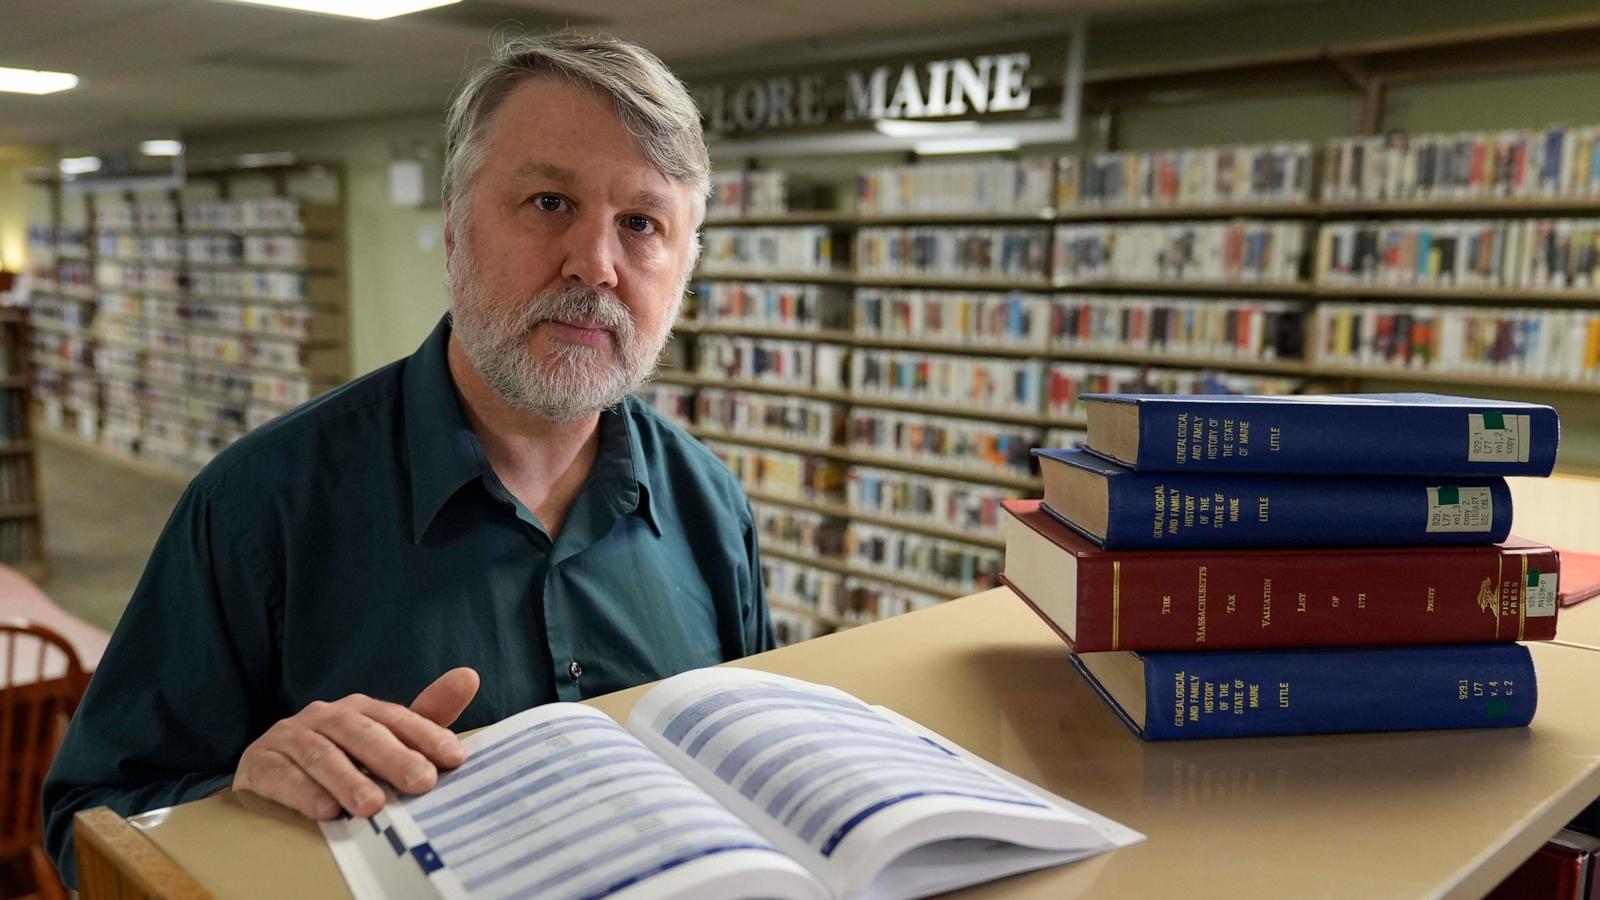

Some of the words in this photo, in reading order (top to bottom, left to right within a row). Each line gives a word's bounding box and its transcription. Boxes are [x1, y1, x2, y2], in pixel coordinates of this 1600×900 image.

[844, 52, 1031, 120] MAINE
[1193, 416, 1203, 442] FAMILY
[1209, 418, 1218, 427] OF
[1224, 419, 1234, 442] STATE
[1240, 421, 1249, 444] MAINE
[1177, 412, 1188, 464] GENEALOGICAL
[1208, 429, 1218, 459] HISTORY
[1271, 427, 1280, 451] LITTLE
[1474, 432, 1482, 454] 929.1
[1484, 441, 1492, 454] L77
[1495, 431, 1503, 454] vol.2
[1507, 436, 1515, 454] copy
[1192, 444, 1201, 460] AND
[1223, 443, 1232, 457] THE
[1239, 447, 1248, 456] OF
[1170, 488, 1179, 517] FAMILY
[1201, 497, 1209, 511] THE
[1215, 493, 1224, 503] OF
[1153, 484, 1165, 538] GENEALOGICAL
[1185, 495, 1194, 527] HISTORY
[1200, 514, 1209, 524] OF
[1214, 505, 1224, 528] STATE
[1230, 498, 1239, 522] MAINE
[1259, 497, 1268, 522] LITTLE
[1432, 505, 1440, 526] 929.1
[1442, 514, 1450, 526] L77
[1464, 507, 1472, 526] copy
[1169, 519, 1178, 534] AND
[1162, 595, 1171, 614] THE
[1196, 566, 1208, 642] MASSACHUSETTS
[1227, 594, 1236, 613] TAX
[1262, 578, 1272, 628] VALUATION
[1298, 593, 1306, 612] LIST
[1358, 593, 1366, 609] 1771
[1502, 581, 1511, 616] PICTON
[1510, 582, 1518, 615] PRESS
[1190, 675, 1199, 702] FAMILY
[1220, 683, 1229, 697] THE
[1235, 679, 1244, 689] OF
[1280, 683, 1288, 707] LITTLE
[1459, 680, 1468, 700] 929.1
[1474, 682, 1483, 696] L77
[1175, 671, 1184, 727] GENEALOGICAL
[1204, 682, 1214, 714] HISTORY
[1220, 699, 1228, 710] OF
[1234, 691, 1244, 714] STATE
[1250, 684, 1259, 708] MAINE
[1189, 703, 1198, 722] AND
